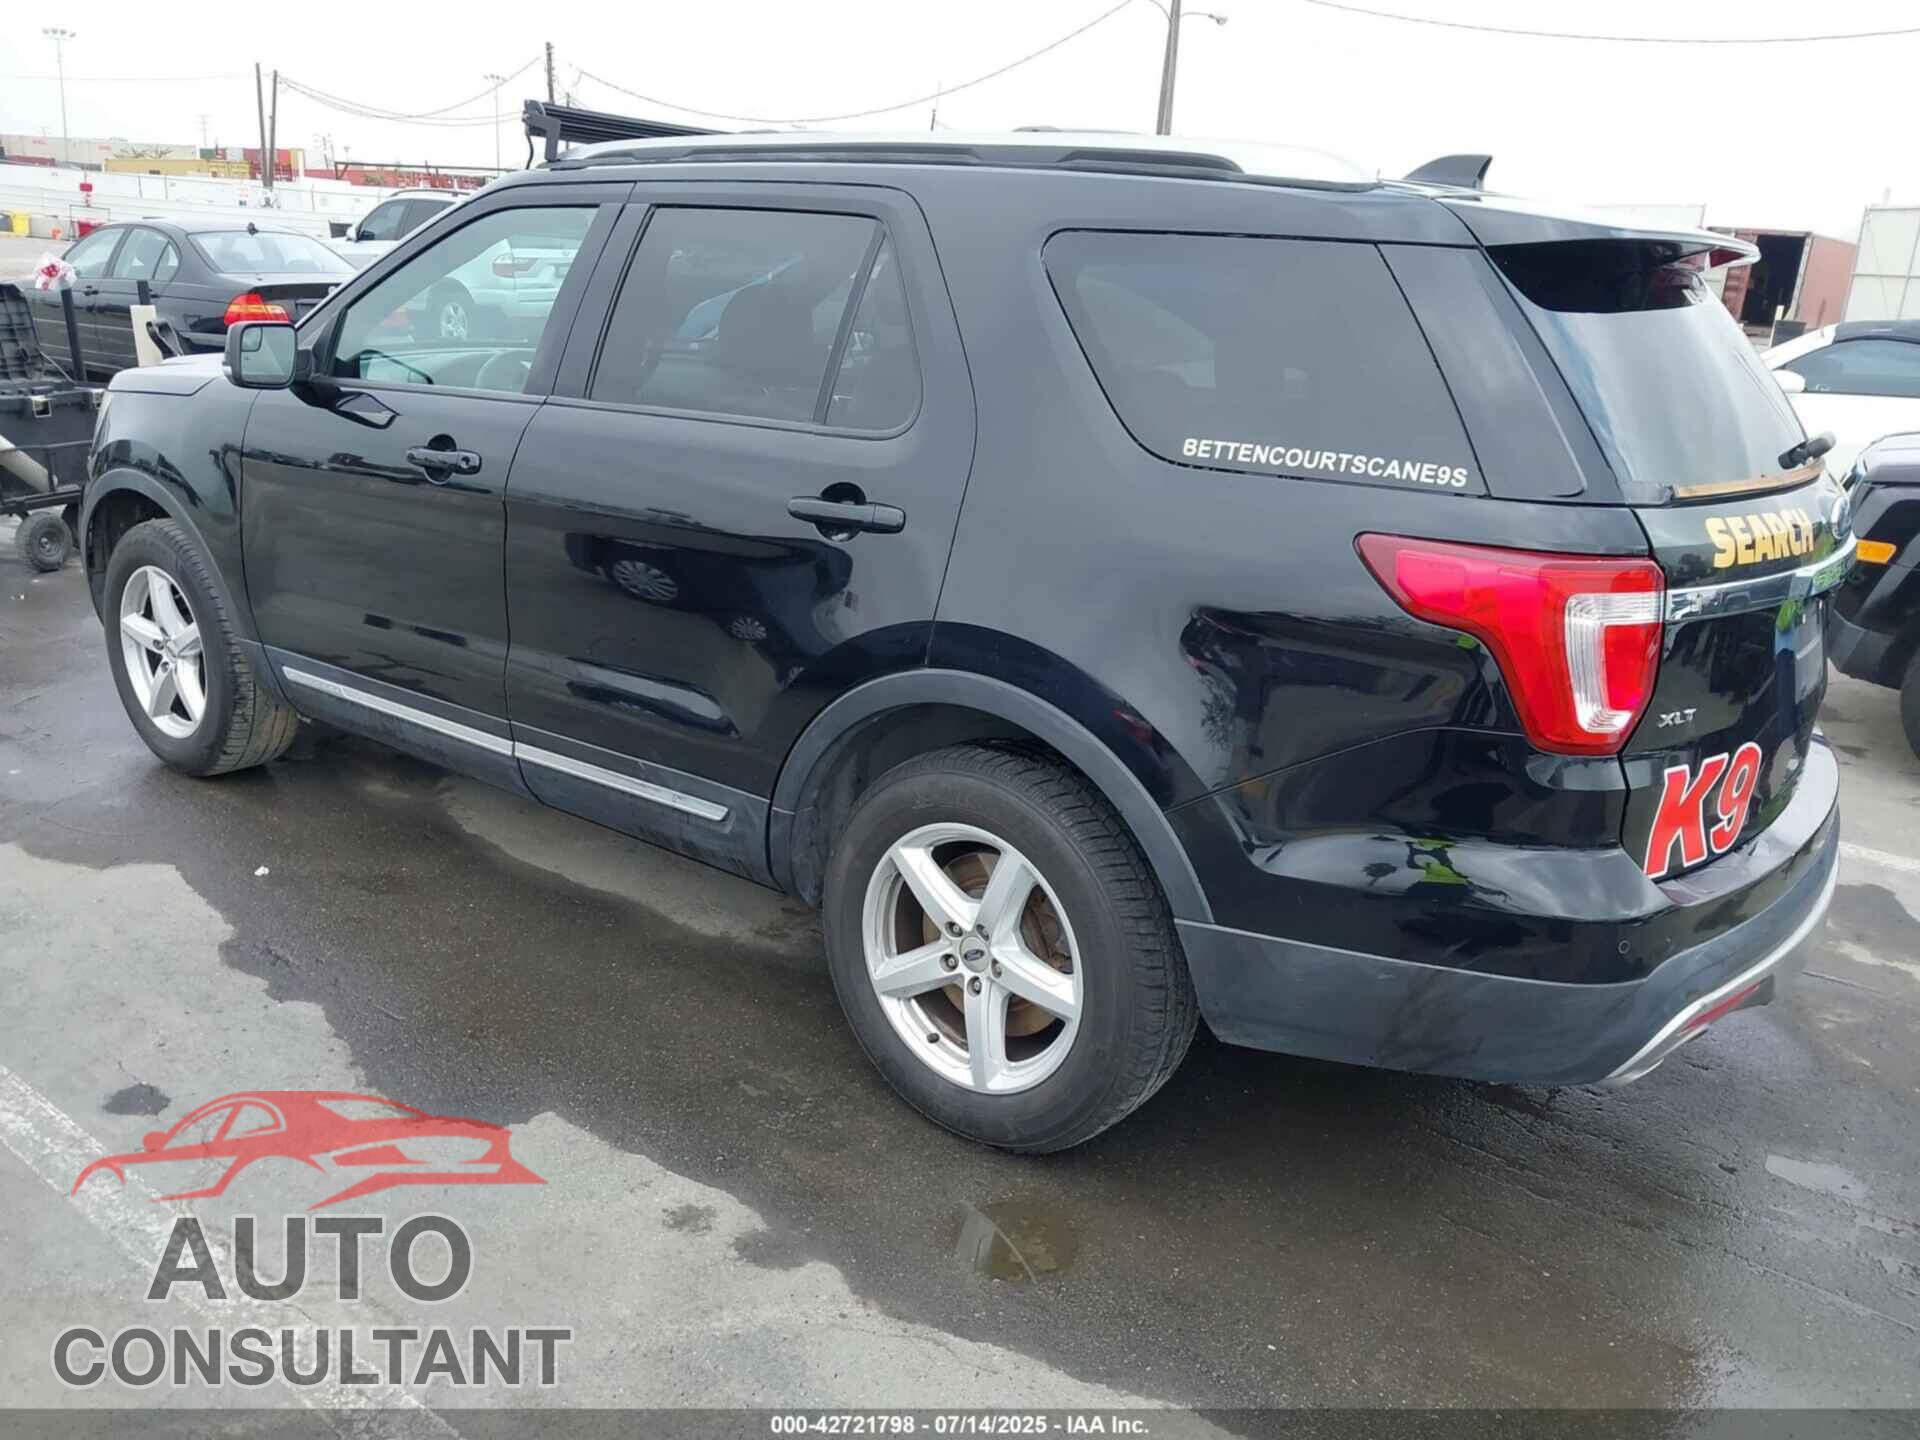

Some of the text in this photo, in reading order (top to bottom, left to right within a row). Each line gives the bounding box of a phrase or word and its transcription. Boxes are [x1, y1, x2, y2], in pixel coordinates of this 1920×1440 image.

[1183, 438, 1468, 487] BETTENCOURTSCANE9S
[1705, 508, 1814, 568] SEARCH
[1658, 708, 1696, 728] XLT
[1643, 741, 1762, 878] K9
